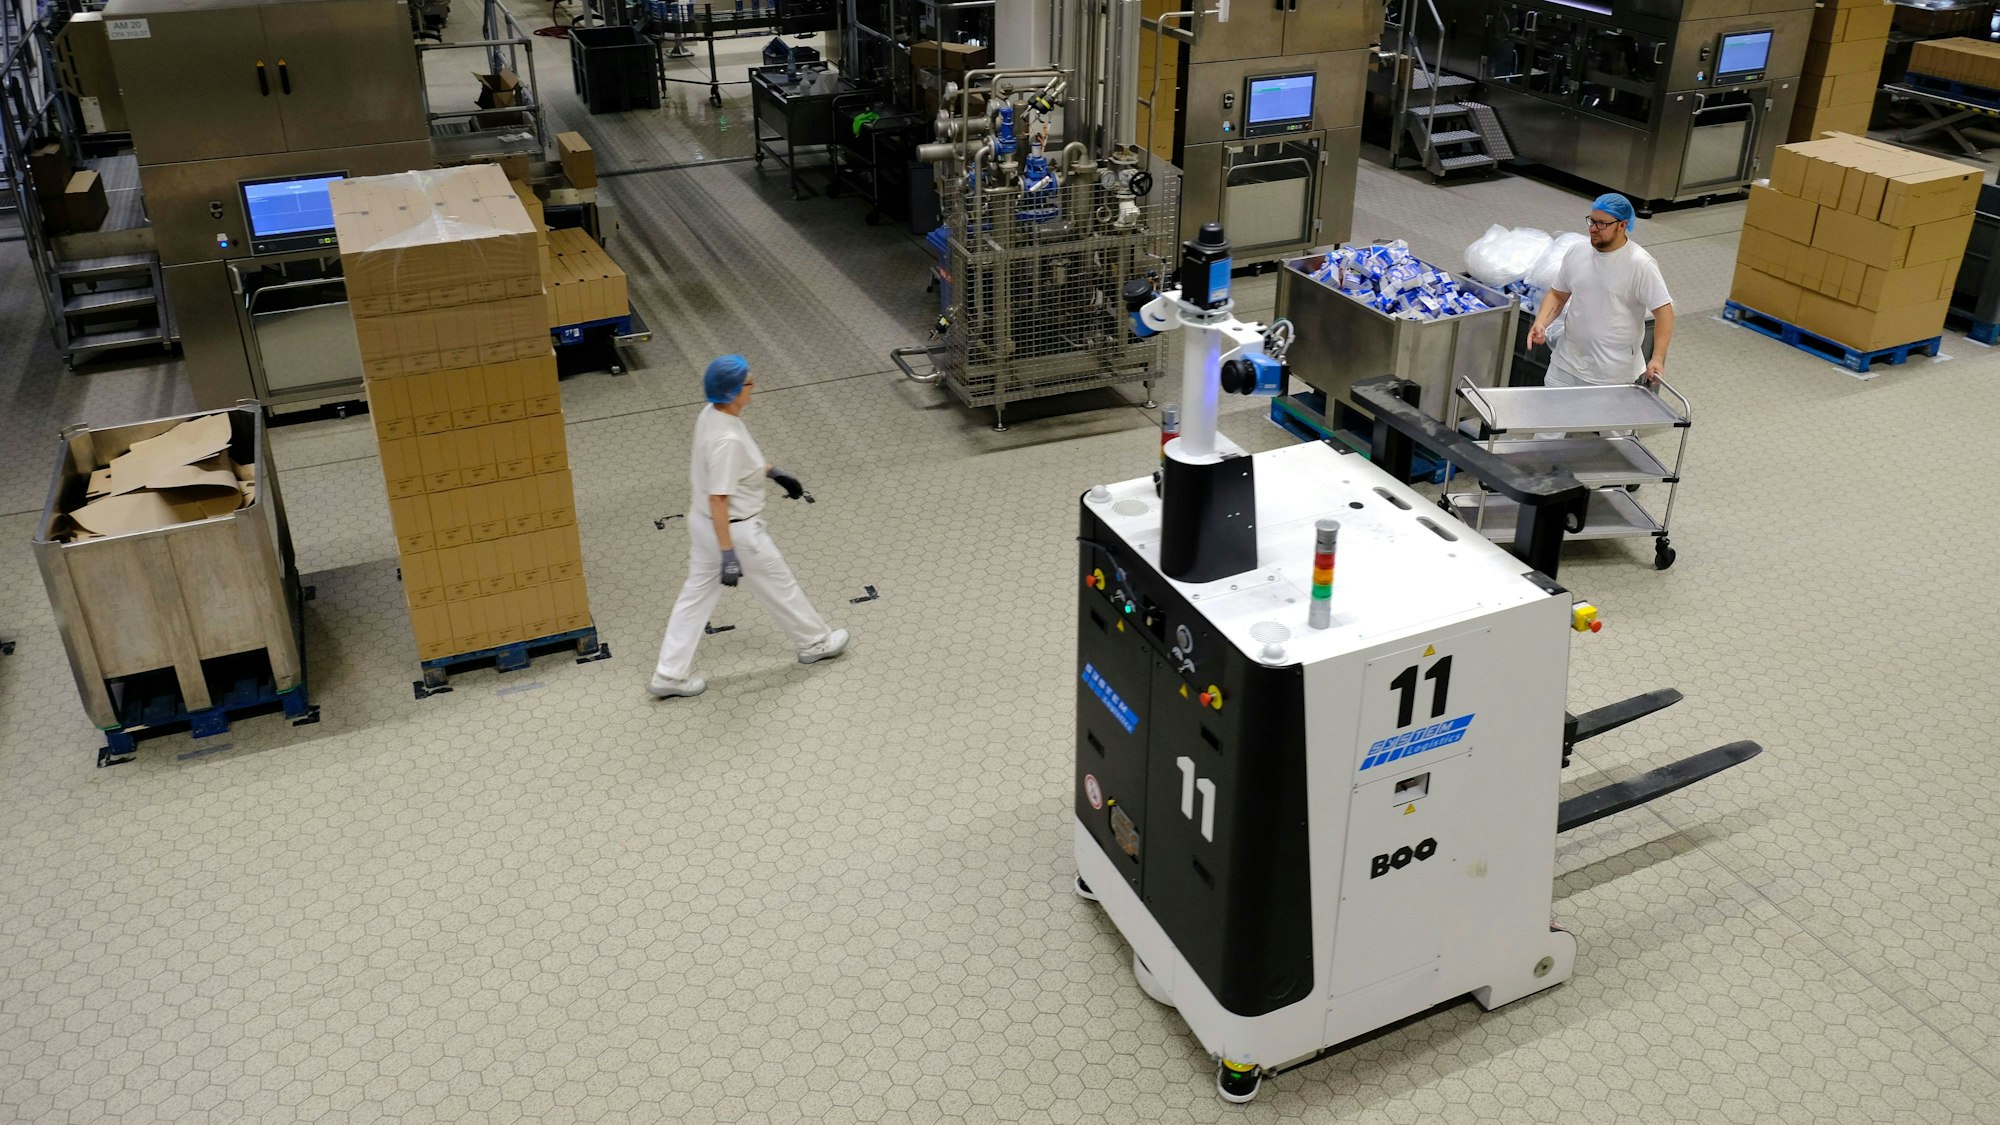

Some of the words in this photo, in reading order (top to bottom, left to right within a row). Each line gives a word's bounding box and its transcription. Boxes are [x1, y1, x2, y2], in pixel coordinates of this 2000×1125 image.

[113, 22, 128, 30] AM
[130, 21, 142, 29] 20
[1085, 663, 1129, 713] SYSTEM
[1390, 654, 1453, 729] 11
[1368, 721, 1455, 756] SYSTEM
[1406, 732, 1462, 755] Logistics
[1176, 756, 1217, 843] 11
[1370, 837, 1437, 879] BOO
